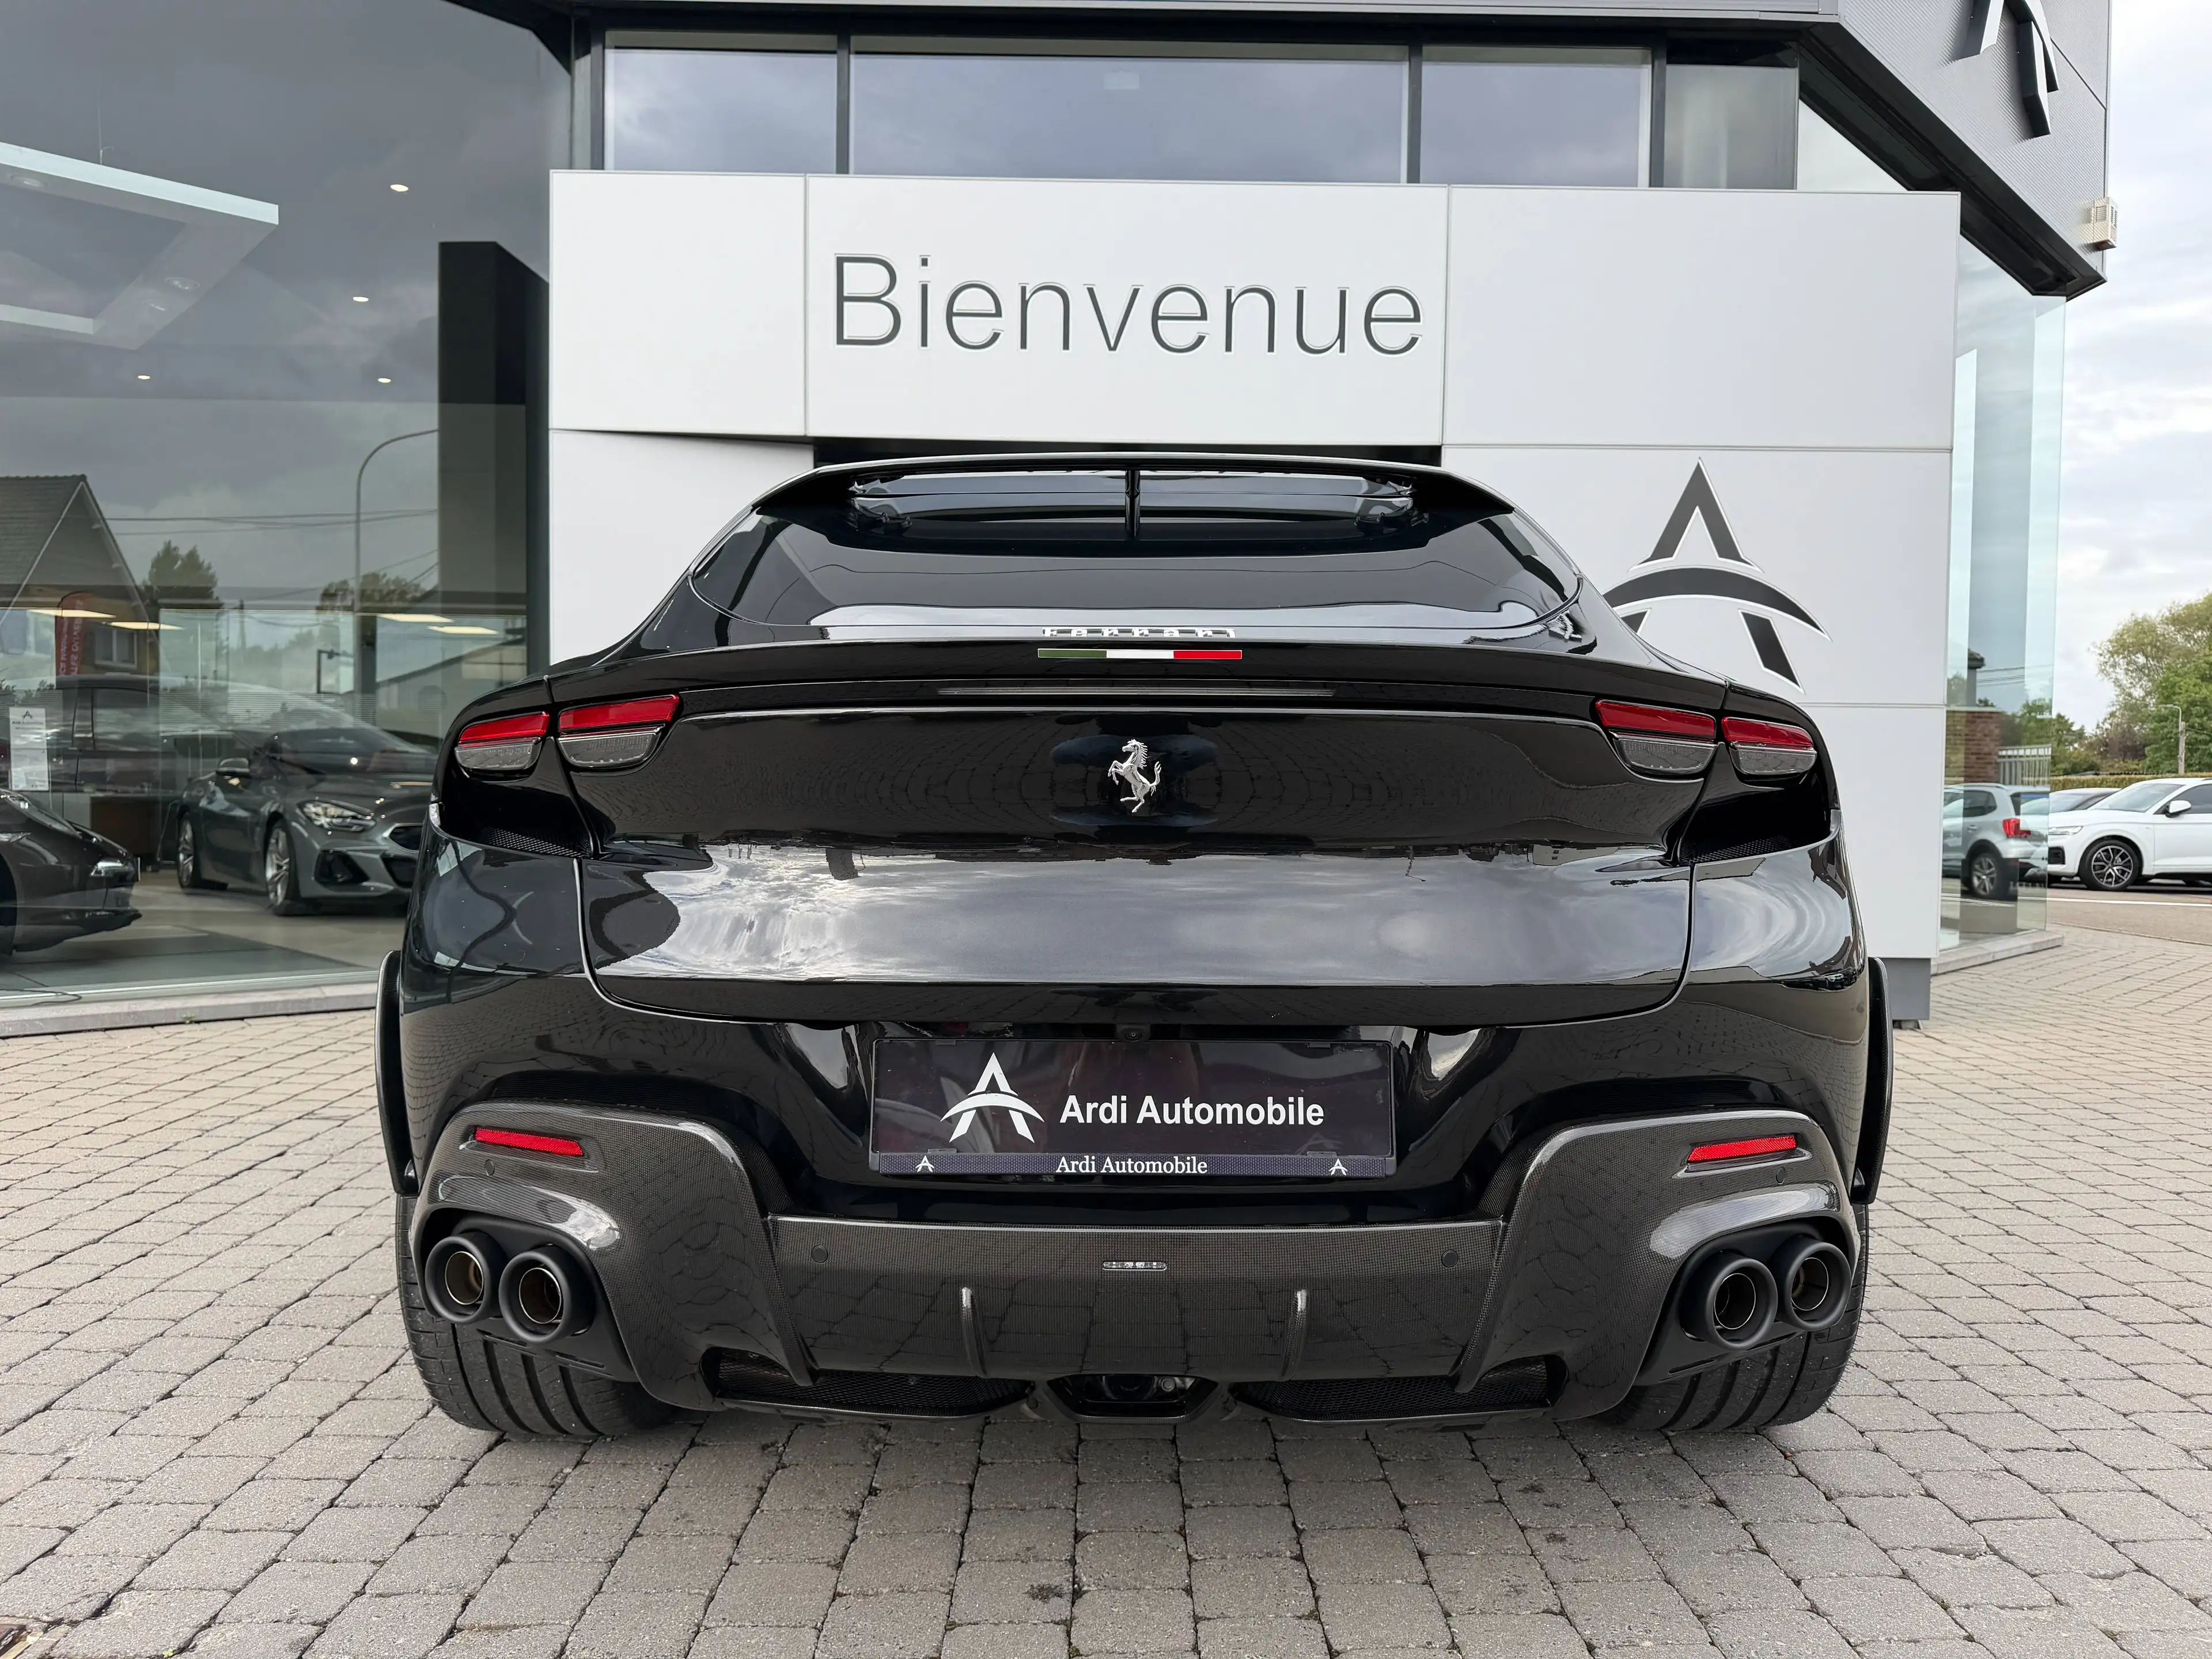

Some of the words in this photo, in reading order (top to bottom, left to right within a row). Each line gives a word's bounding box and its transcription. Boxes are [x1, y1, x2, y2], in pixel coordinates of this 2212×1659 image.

[834, 253, 1423, 355] Bienvenue
[1059, 1094, 1127, 1124] Ardi
[1136, 1095, 1325, 1126] Automobile
[1055, 1156, 1097, 1173] Ardi
[1100, 1156, 1208, 1174] Automobile
